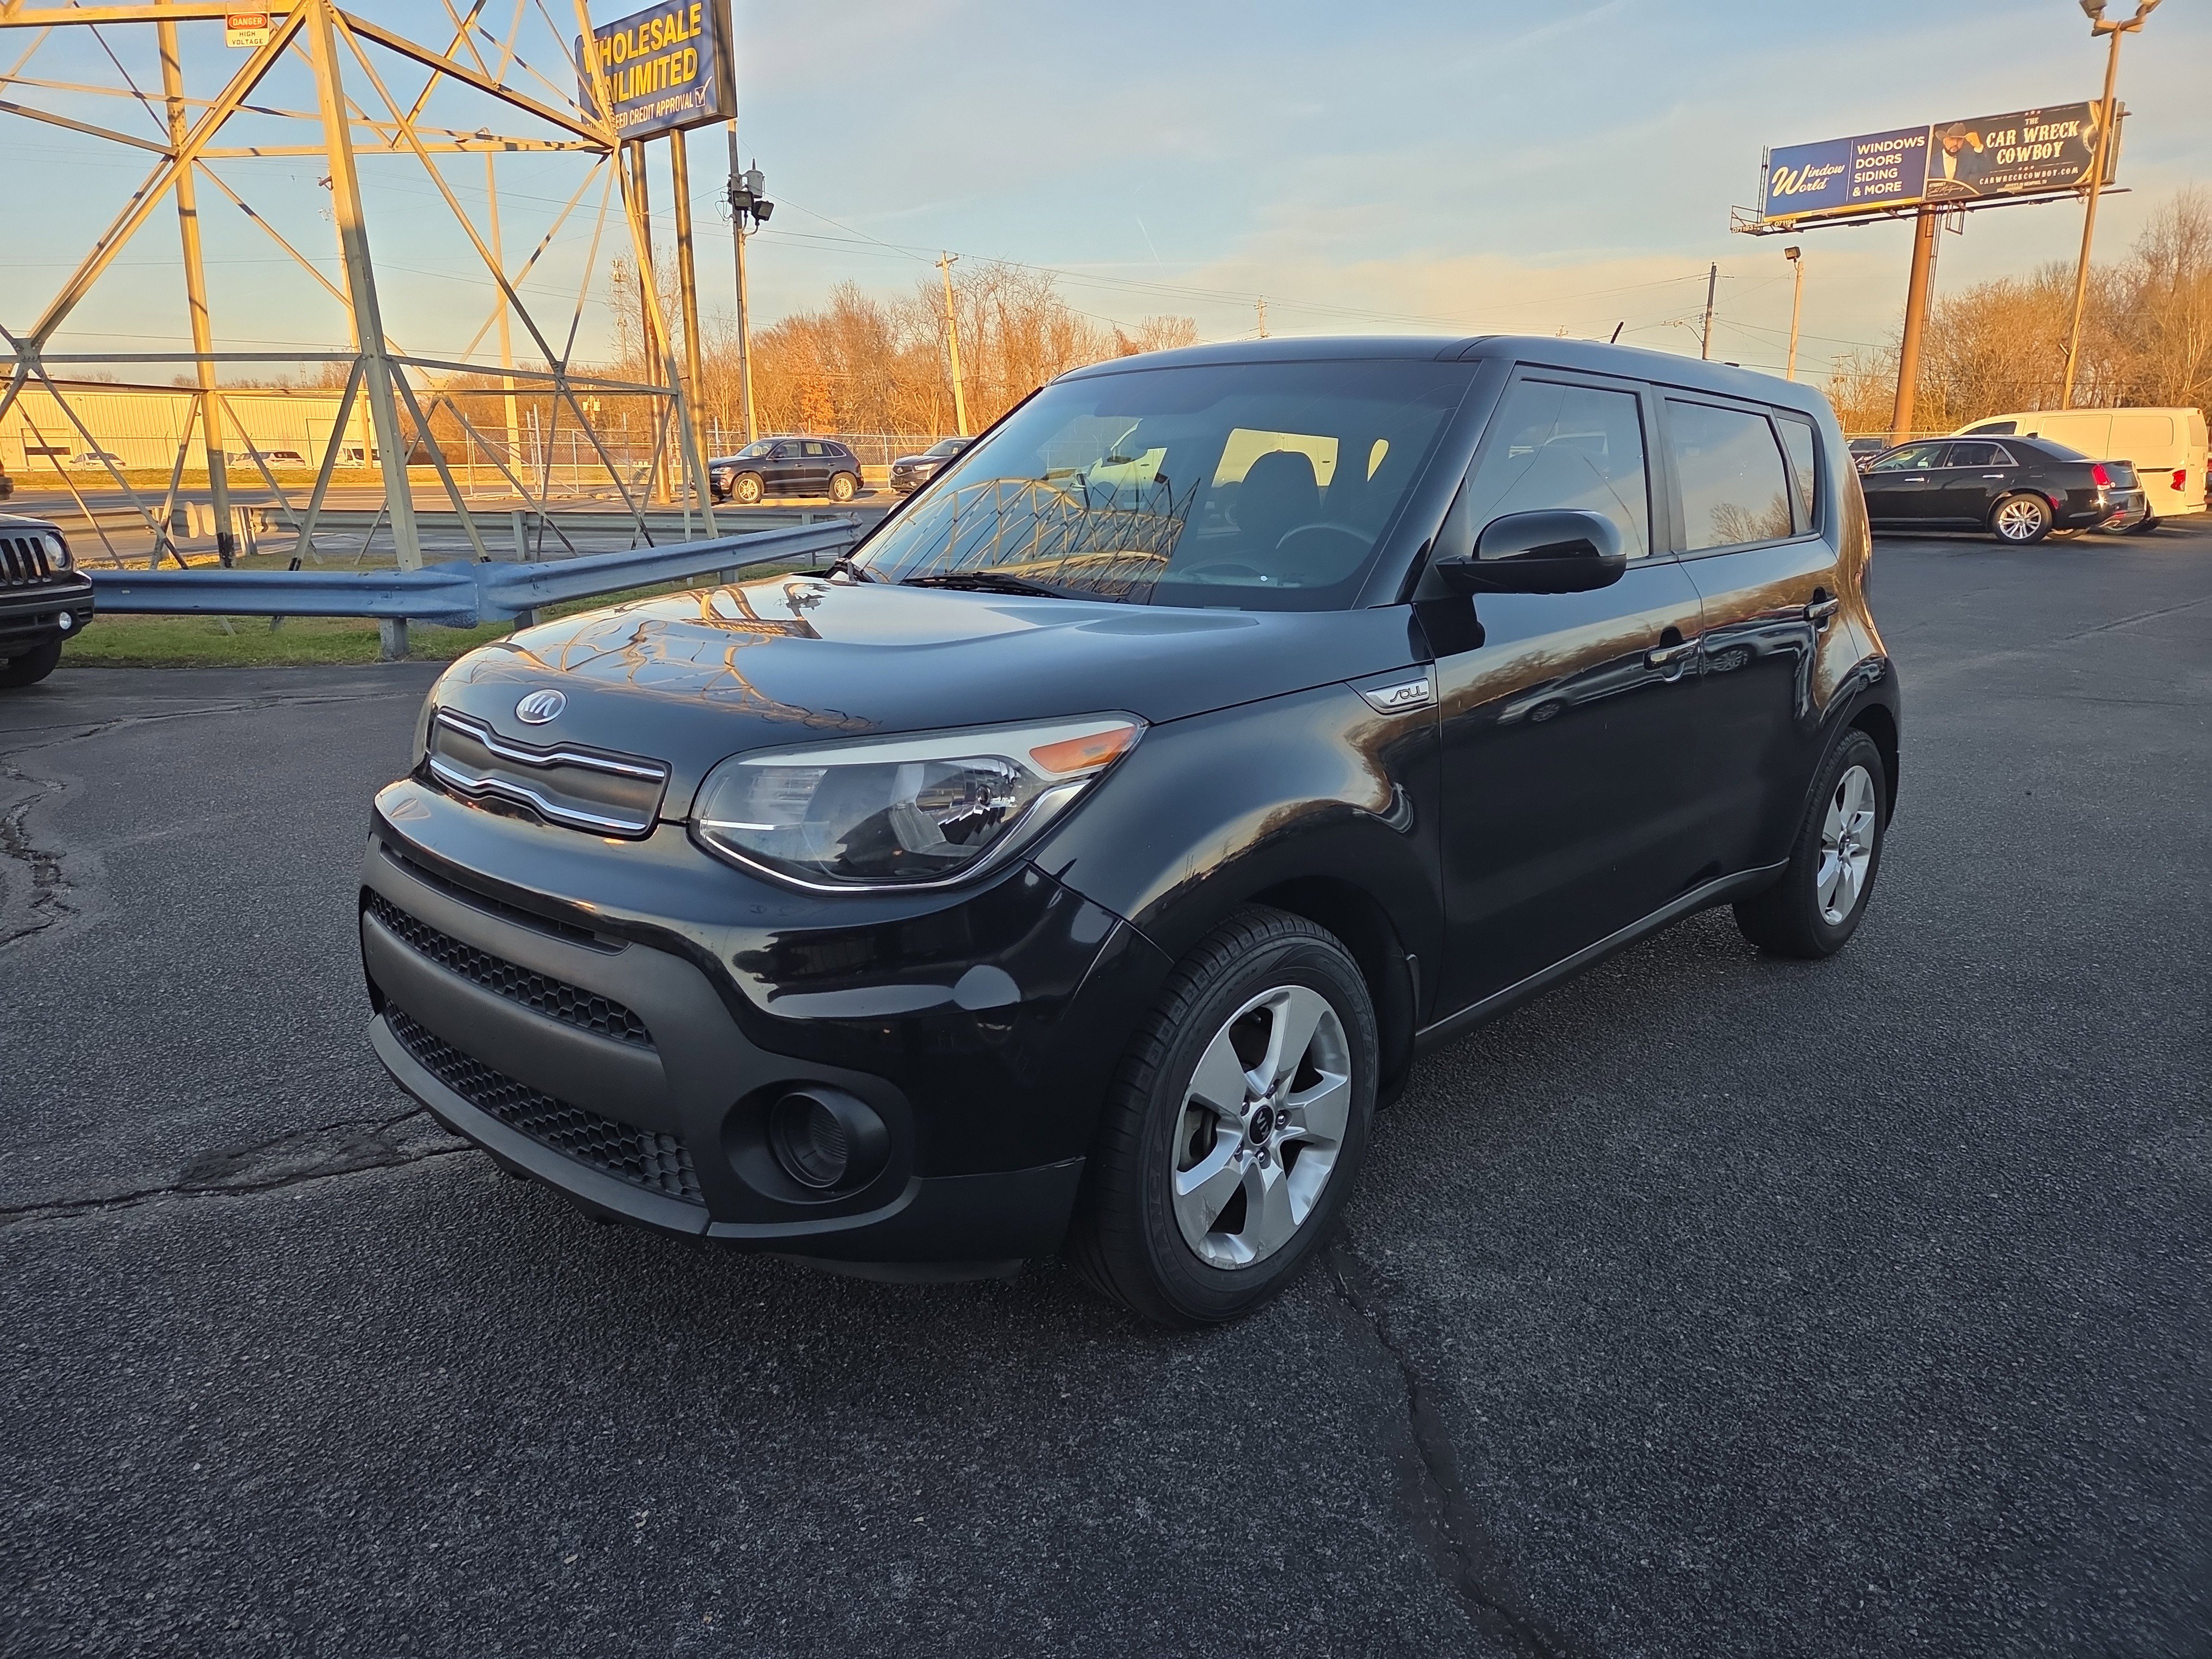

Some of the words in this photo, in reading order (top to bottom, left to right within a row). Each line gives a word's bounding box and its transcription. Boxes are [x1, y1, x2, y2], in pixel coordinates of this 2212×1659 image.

[233, 17, 262, 26] DANGER
[629, 103, 655, 126] CREDIT
[656, 91, 694, 118] APPROVAL
[2025, 117, 2039, 125] THE
[1986, 130, 2016, 149] CAR
[2023, 120, 2080, 143] WRECK
[1857, 136, 1925, 155] WINDOWS
[1997, 141, 2064, 165] COWBOY
[1855, 153, 1902, 169] DOORS
[1771, 163, 1846, 197] Window
[1854, 168, 1898, 183] SIDING
[1853, 187, 1861, 197] &
[1864, 181, 1902, 196] MORE
[1774, 218, 1797, 227] 071194
[1256, 1111, 1269, 1139] KIA
